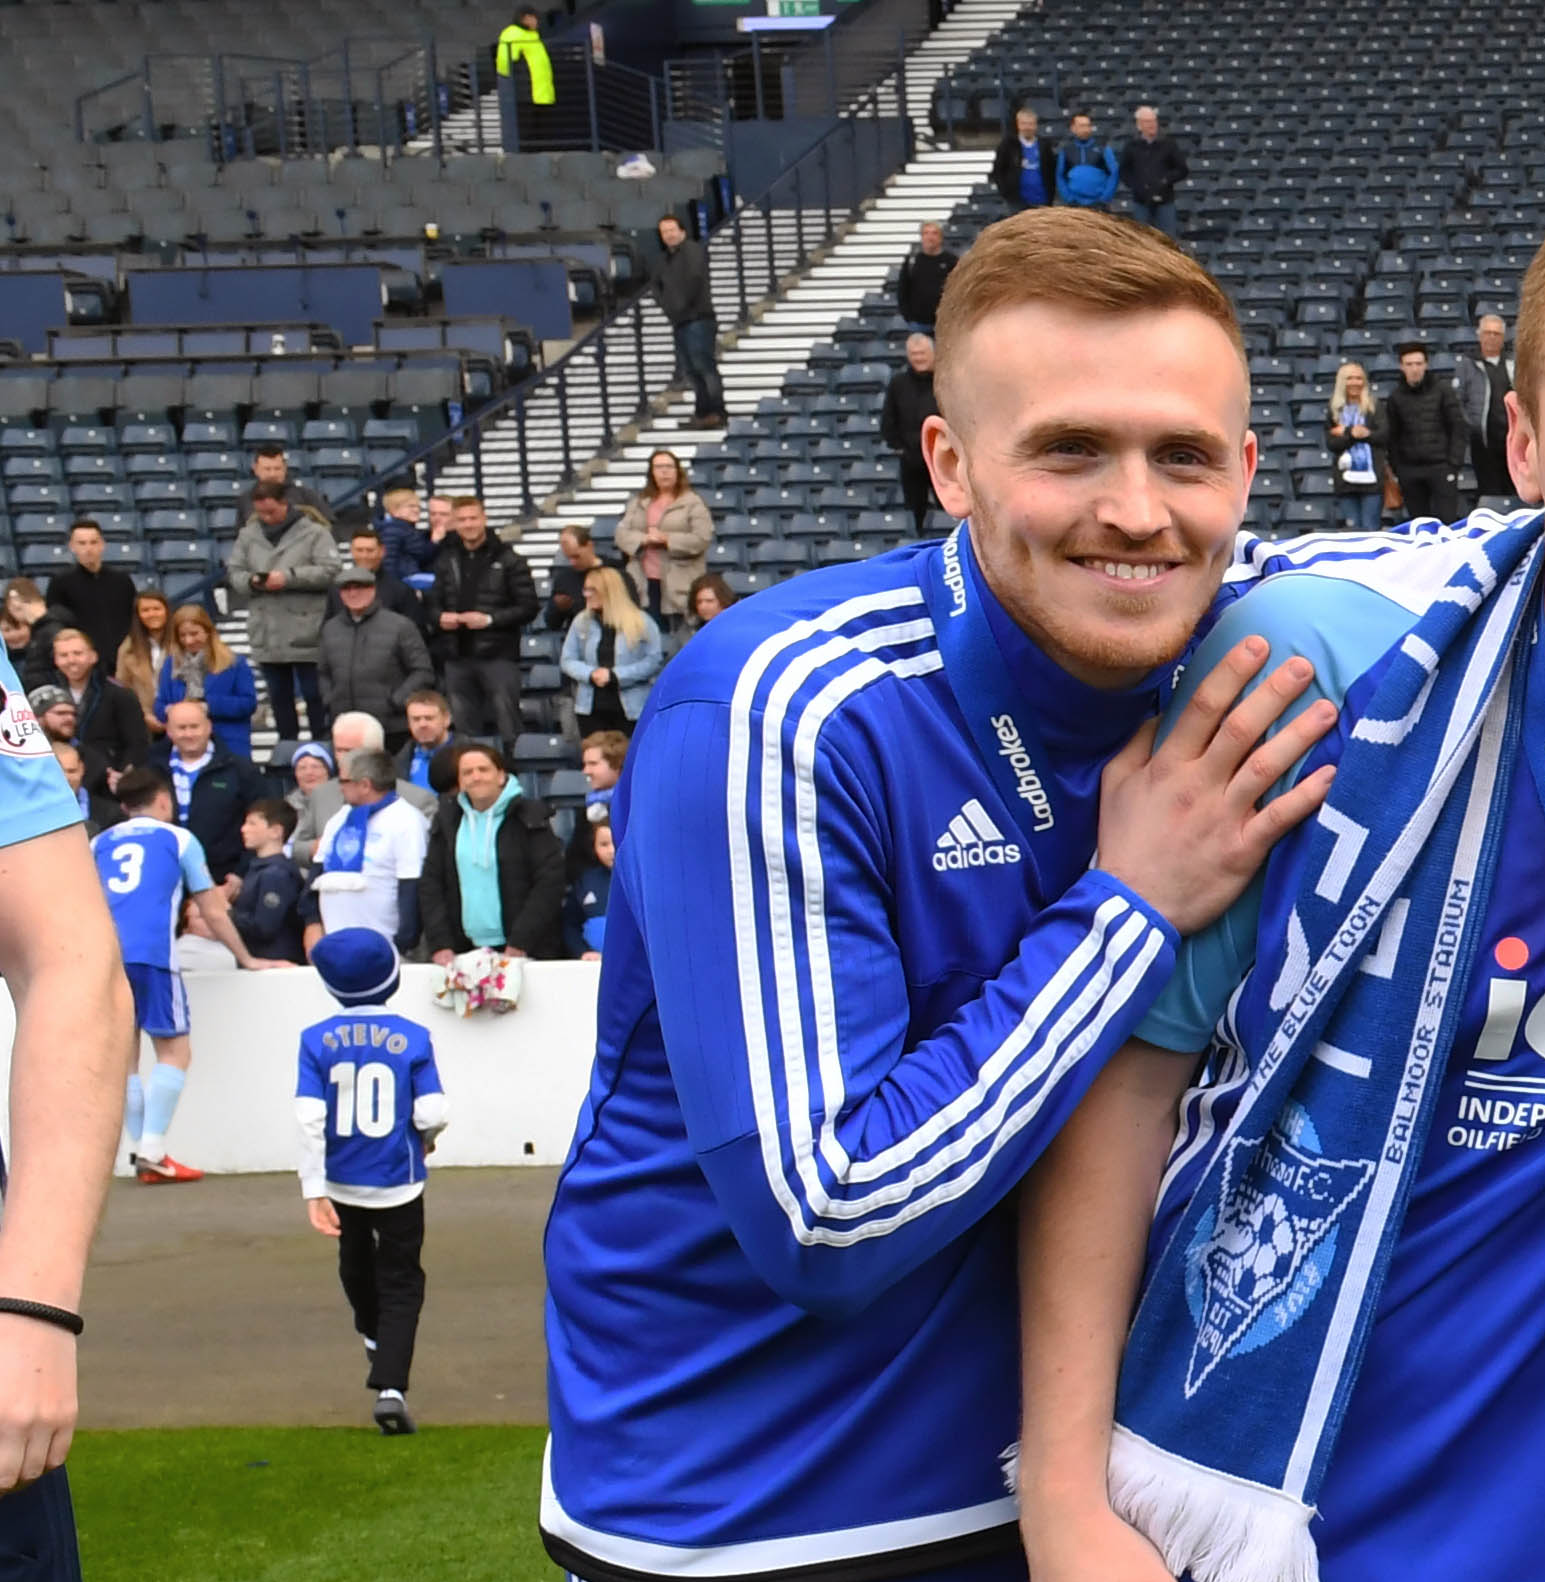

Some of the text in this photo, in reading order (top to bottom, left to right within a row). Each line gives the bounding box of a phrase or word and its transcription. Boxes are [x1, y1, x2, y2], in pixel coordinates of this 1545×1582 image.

[943, 522, 967, 618] Ladbro
[15, 722, 43, 738] LEA
[990, 713, 1055, 832] Ladbrokes
[107, 842, 144, 894] 3
[932, 840, 1021, 873] adidas
[1251, 1042, 1284, 1094] THE
[1282, 972, 1331, 1046] BLUE
[1325, 893, 1382, 965] TOON
[1386, 878, 1471, 1166] BALMOOR STADIUM
[323, 1023, 408, 1055] STEVO
[329, 1062, 395, 1138] 10
